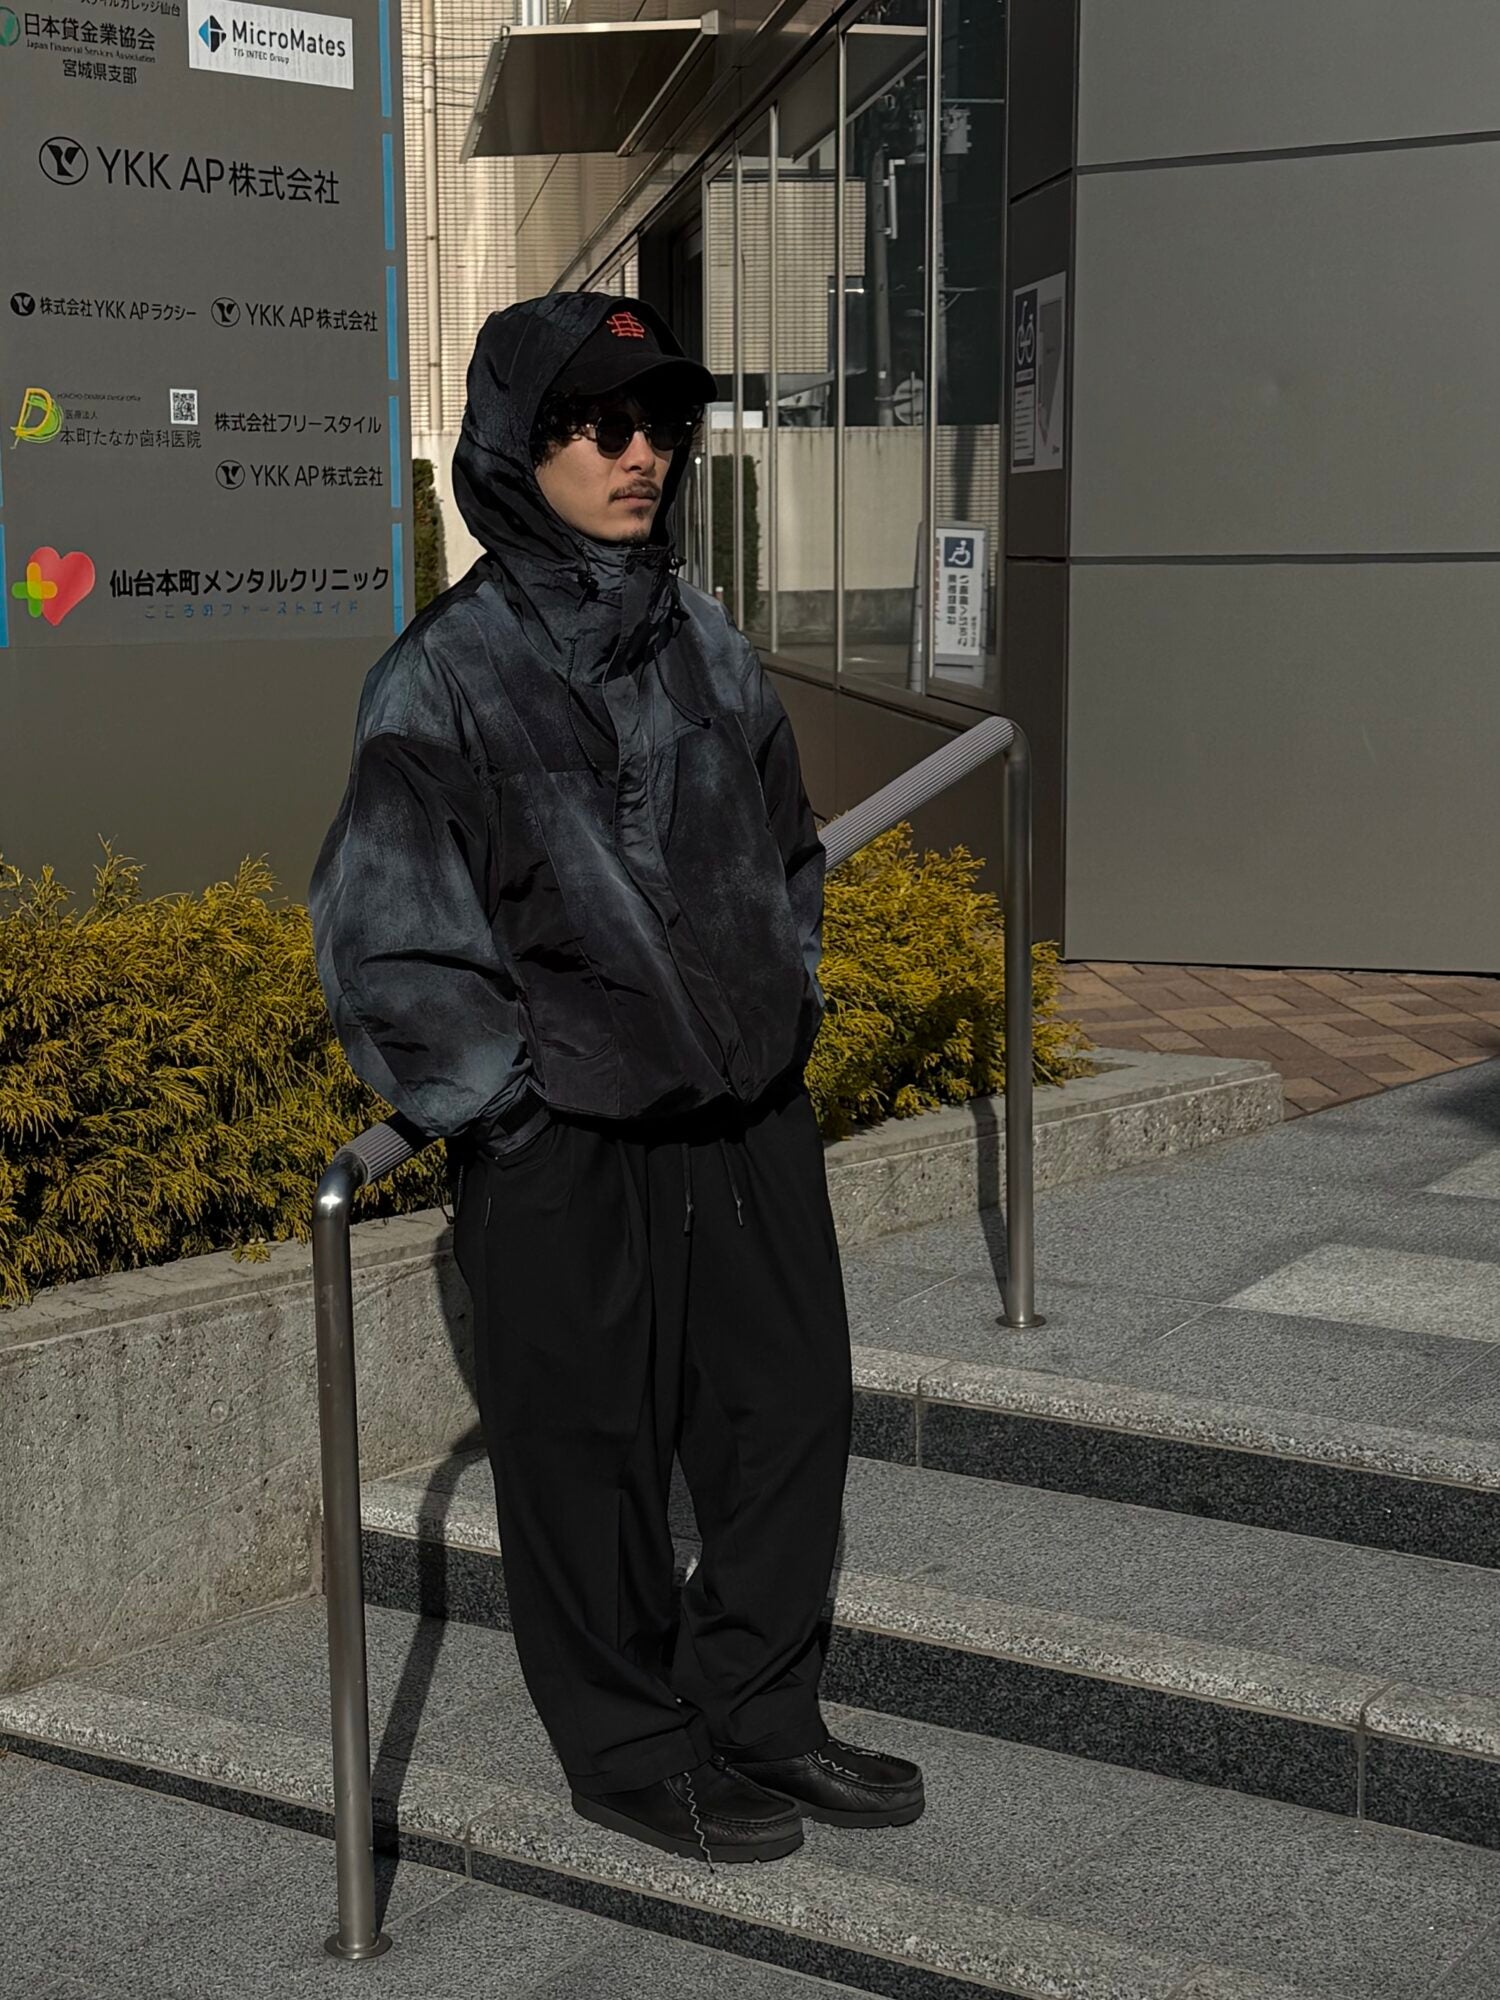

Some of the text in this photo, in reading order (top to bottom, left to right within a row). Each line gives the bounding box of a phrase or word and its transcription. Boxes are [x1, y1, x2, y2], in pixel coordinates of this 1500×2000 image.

[24, 13, 156, 51] 日本貸金業協会
[232, 20, 346, 57] MicroMates
[62, 58, 137, 84] 宮城県支部
[96, 146, 172, 191] YKK
[245, 302, 286, 328] YKK
[214, 412, 382, 435] 株式会社フリースタイル
[60, 427, 202, 449] 本町たなか歯科医院
[249, 464, 290, 487] YKK
[109, 567, 389, 598] 仙台本町メンタルクリニック
